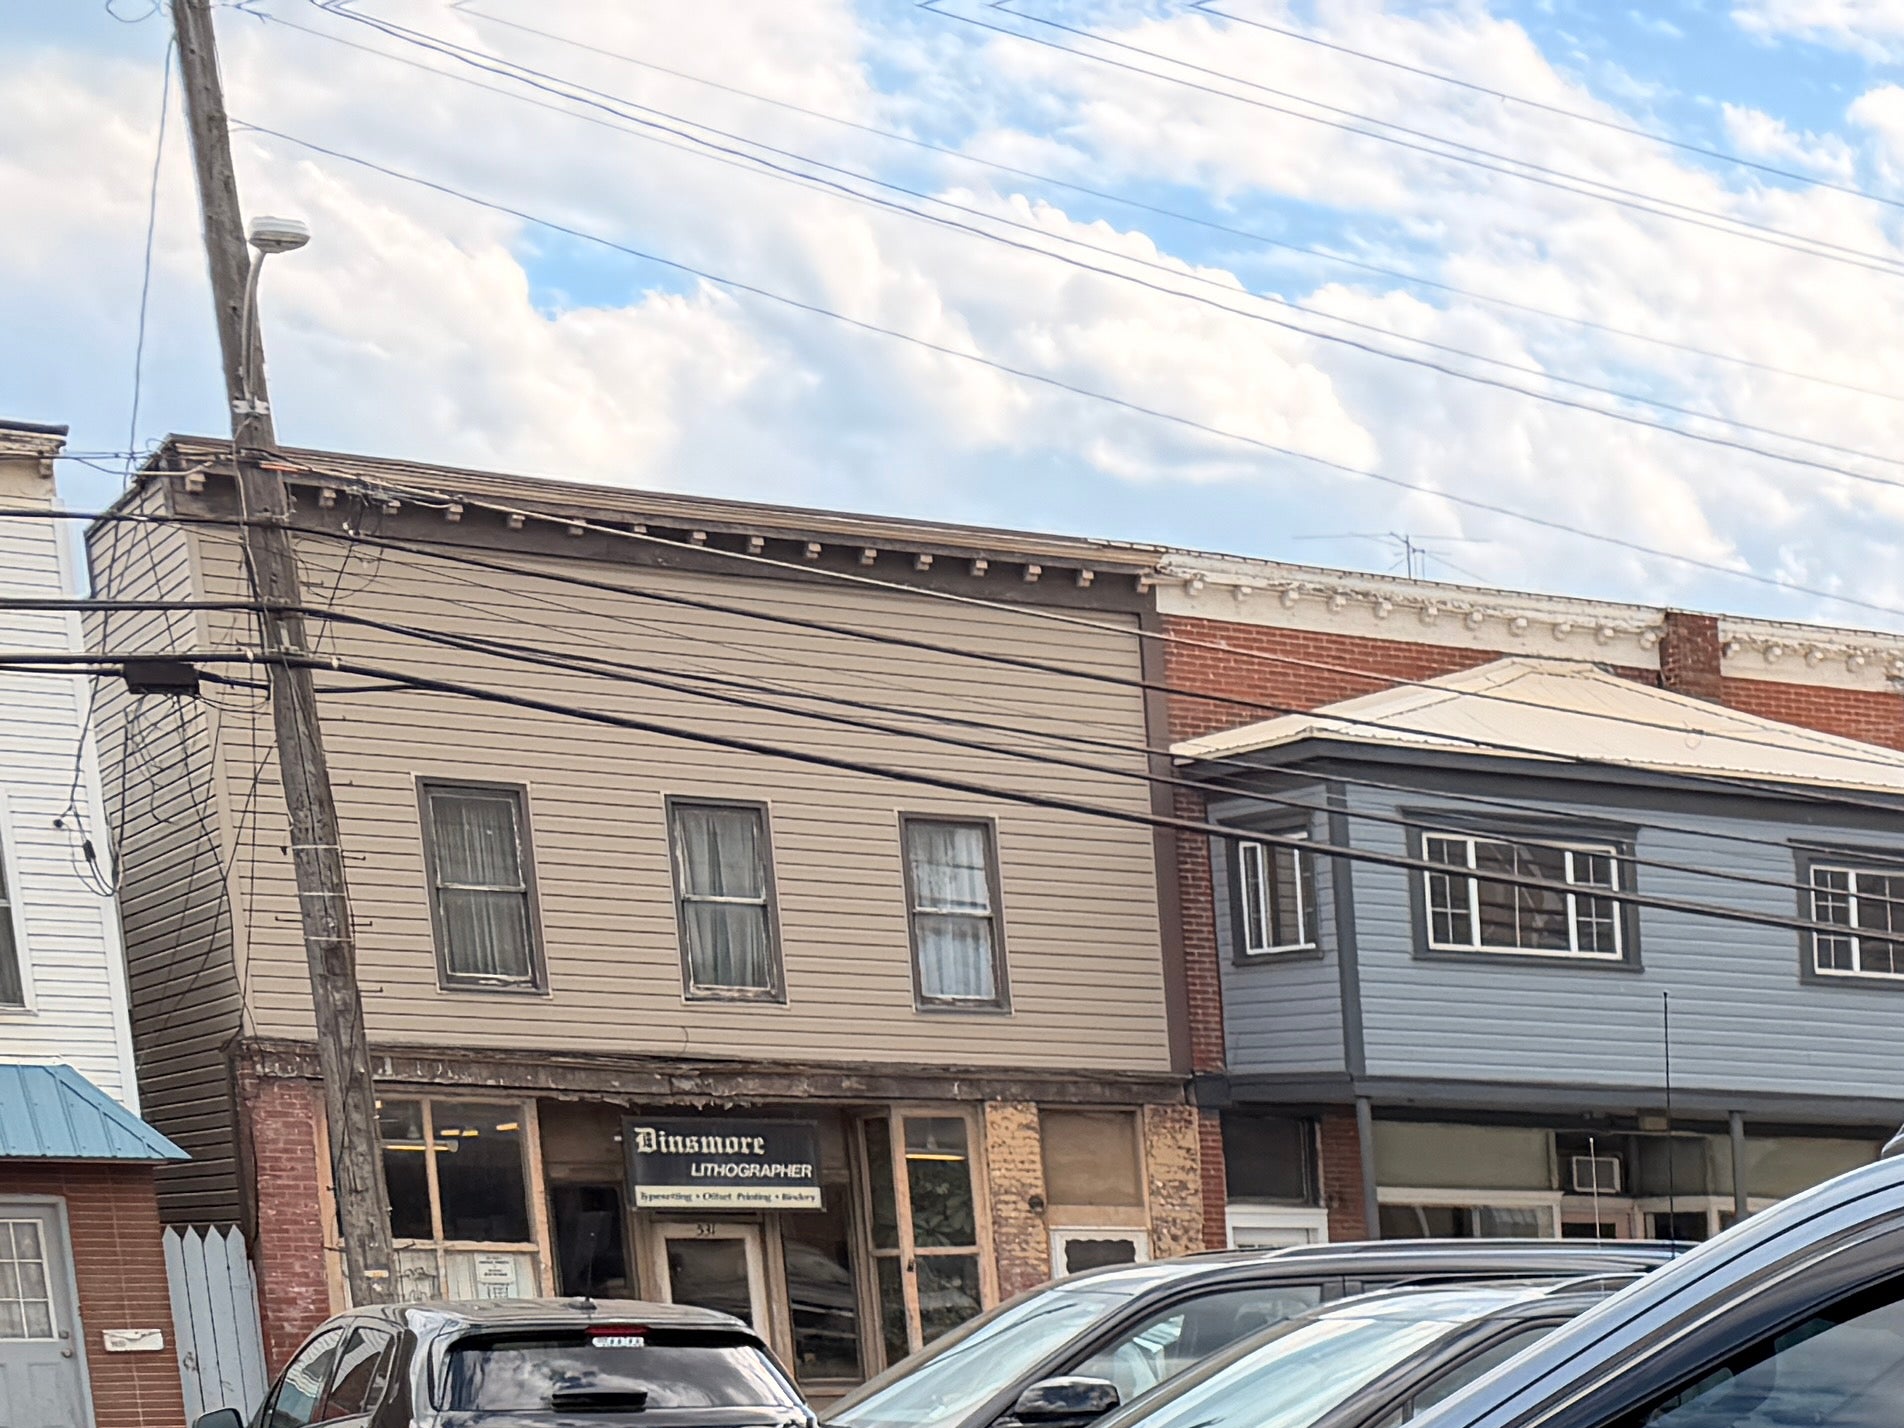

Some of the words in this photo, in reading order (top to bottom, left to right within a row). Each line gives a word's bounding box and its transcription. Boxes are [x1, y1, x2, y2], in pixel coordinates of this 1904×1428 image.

[634, 1127, 766, 1156] Dinsmore
[690, 1162, 813, 1179] LITHOGRAPHER
[640, 1191, 693, 1204] Typesetting
[736, 1192, 773, 1204] Printing
[781, 1192, 816, 1204] Bindery
